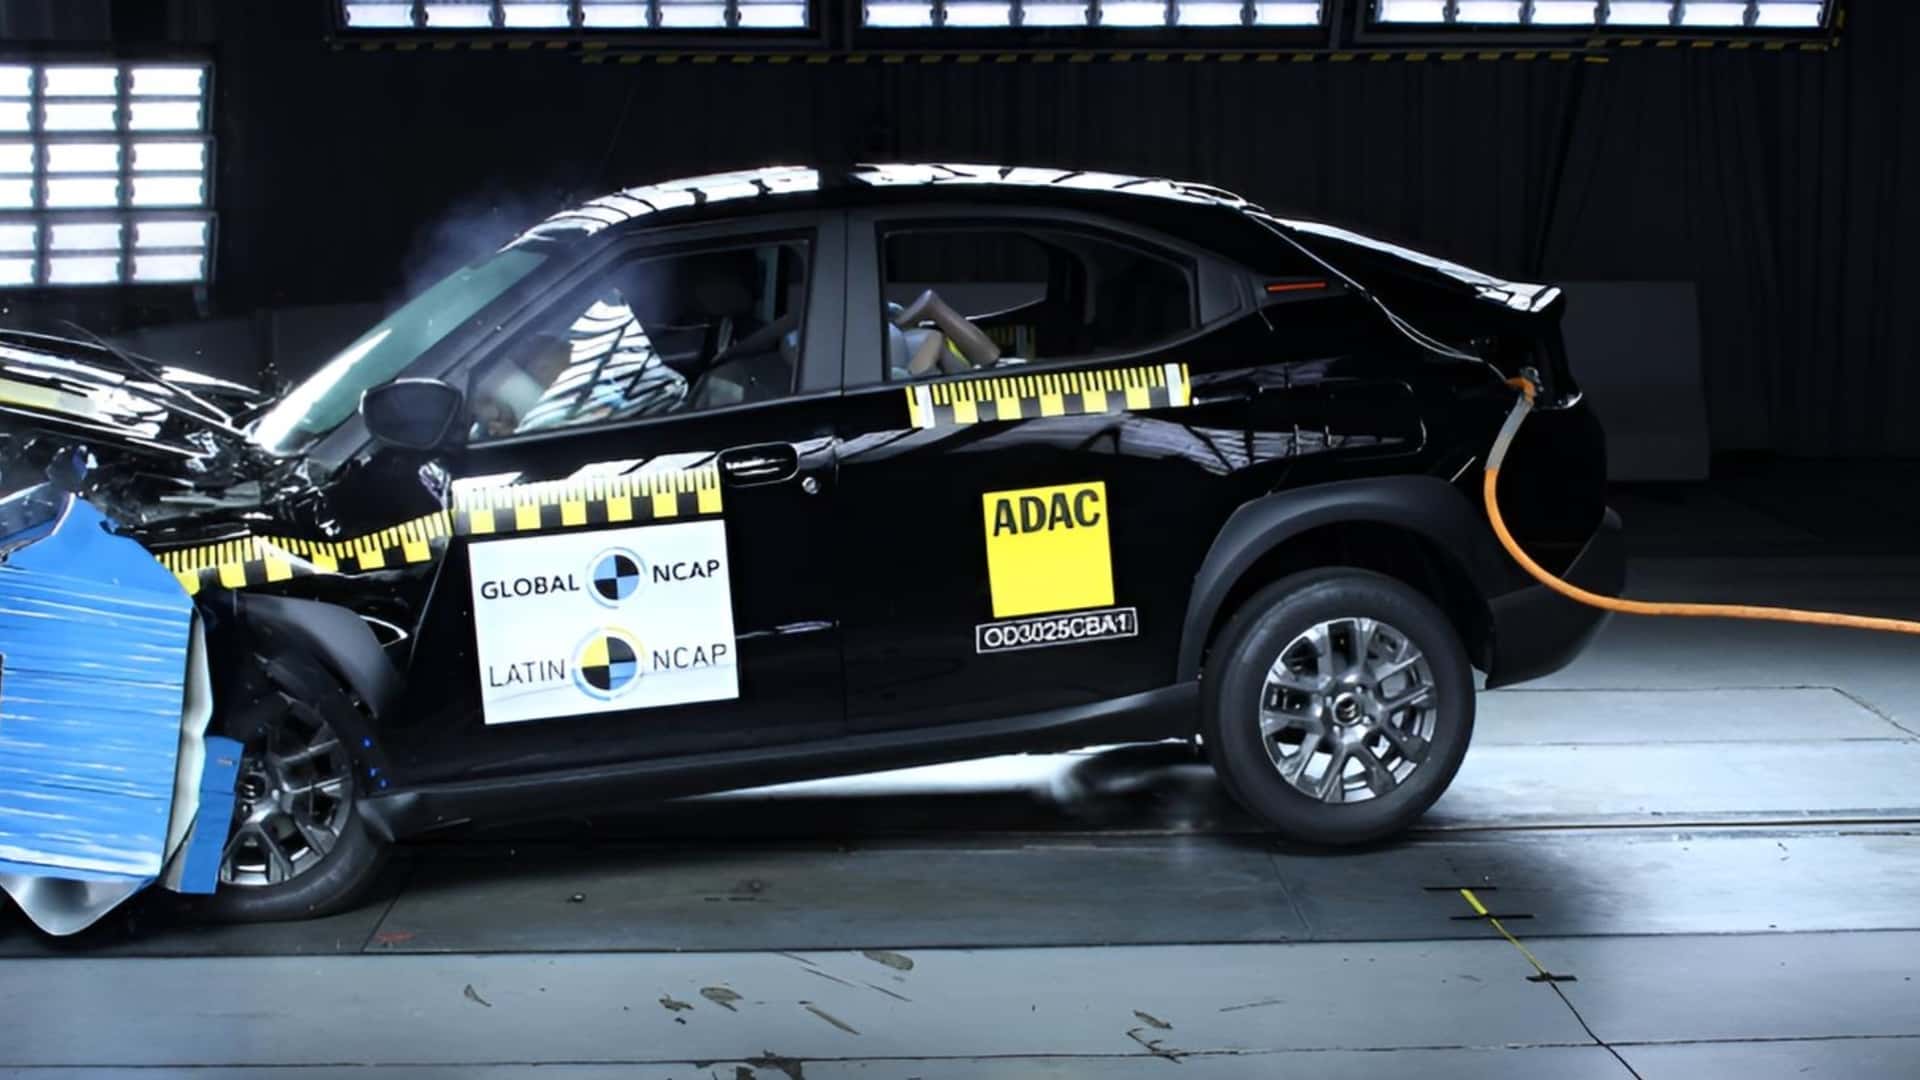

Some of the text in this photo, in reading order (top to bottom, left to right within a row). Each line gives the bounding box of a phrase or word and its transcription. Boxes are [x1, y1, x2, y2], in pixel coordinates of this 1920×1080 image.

[993, 488, 1101, 537] ADAC
[480, 559, 720, 600] GLOBAL NCAP
[489, 643, 728, 688] LATIN NCAP
